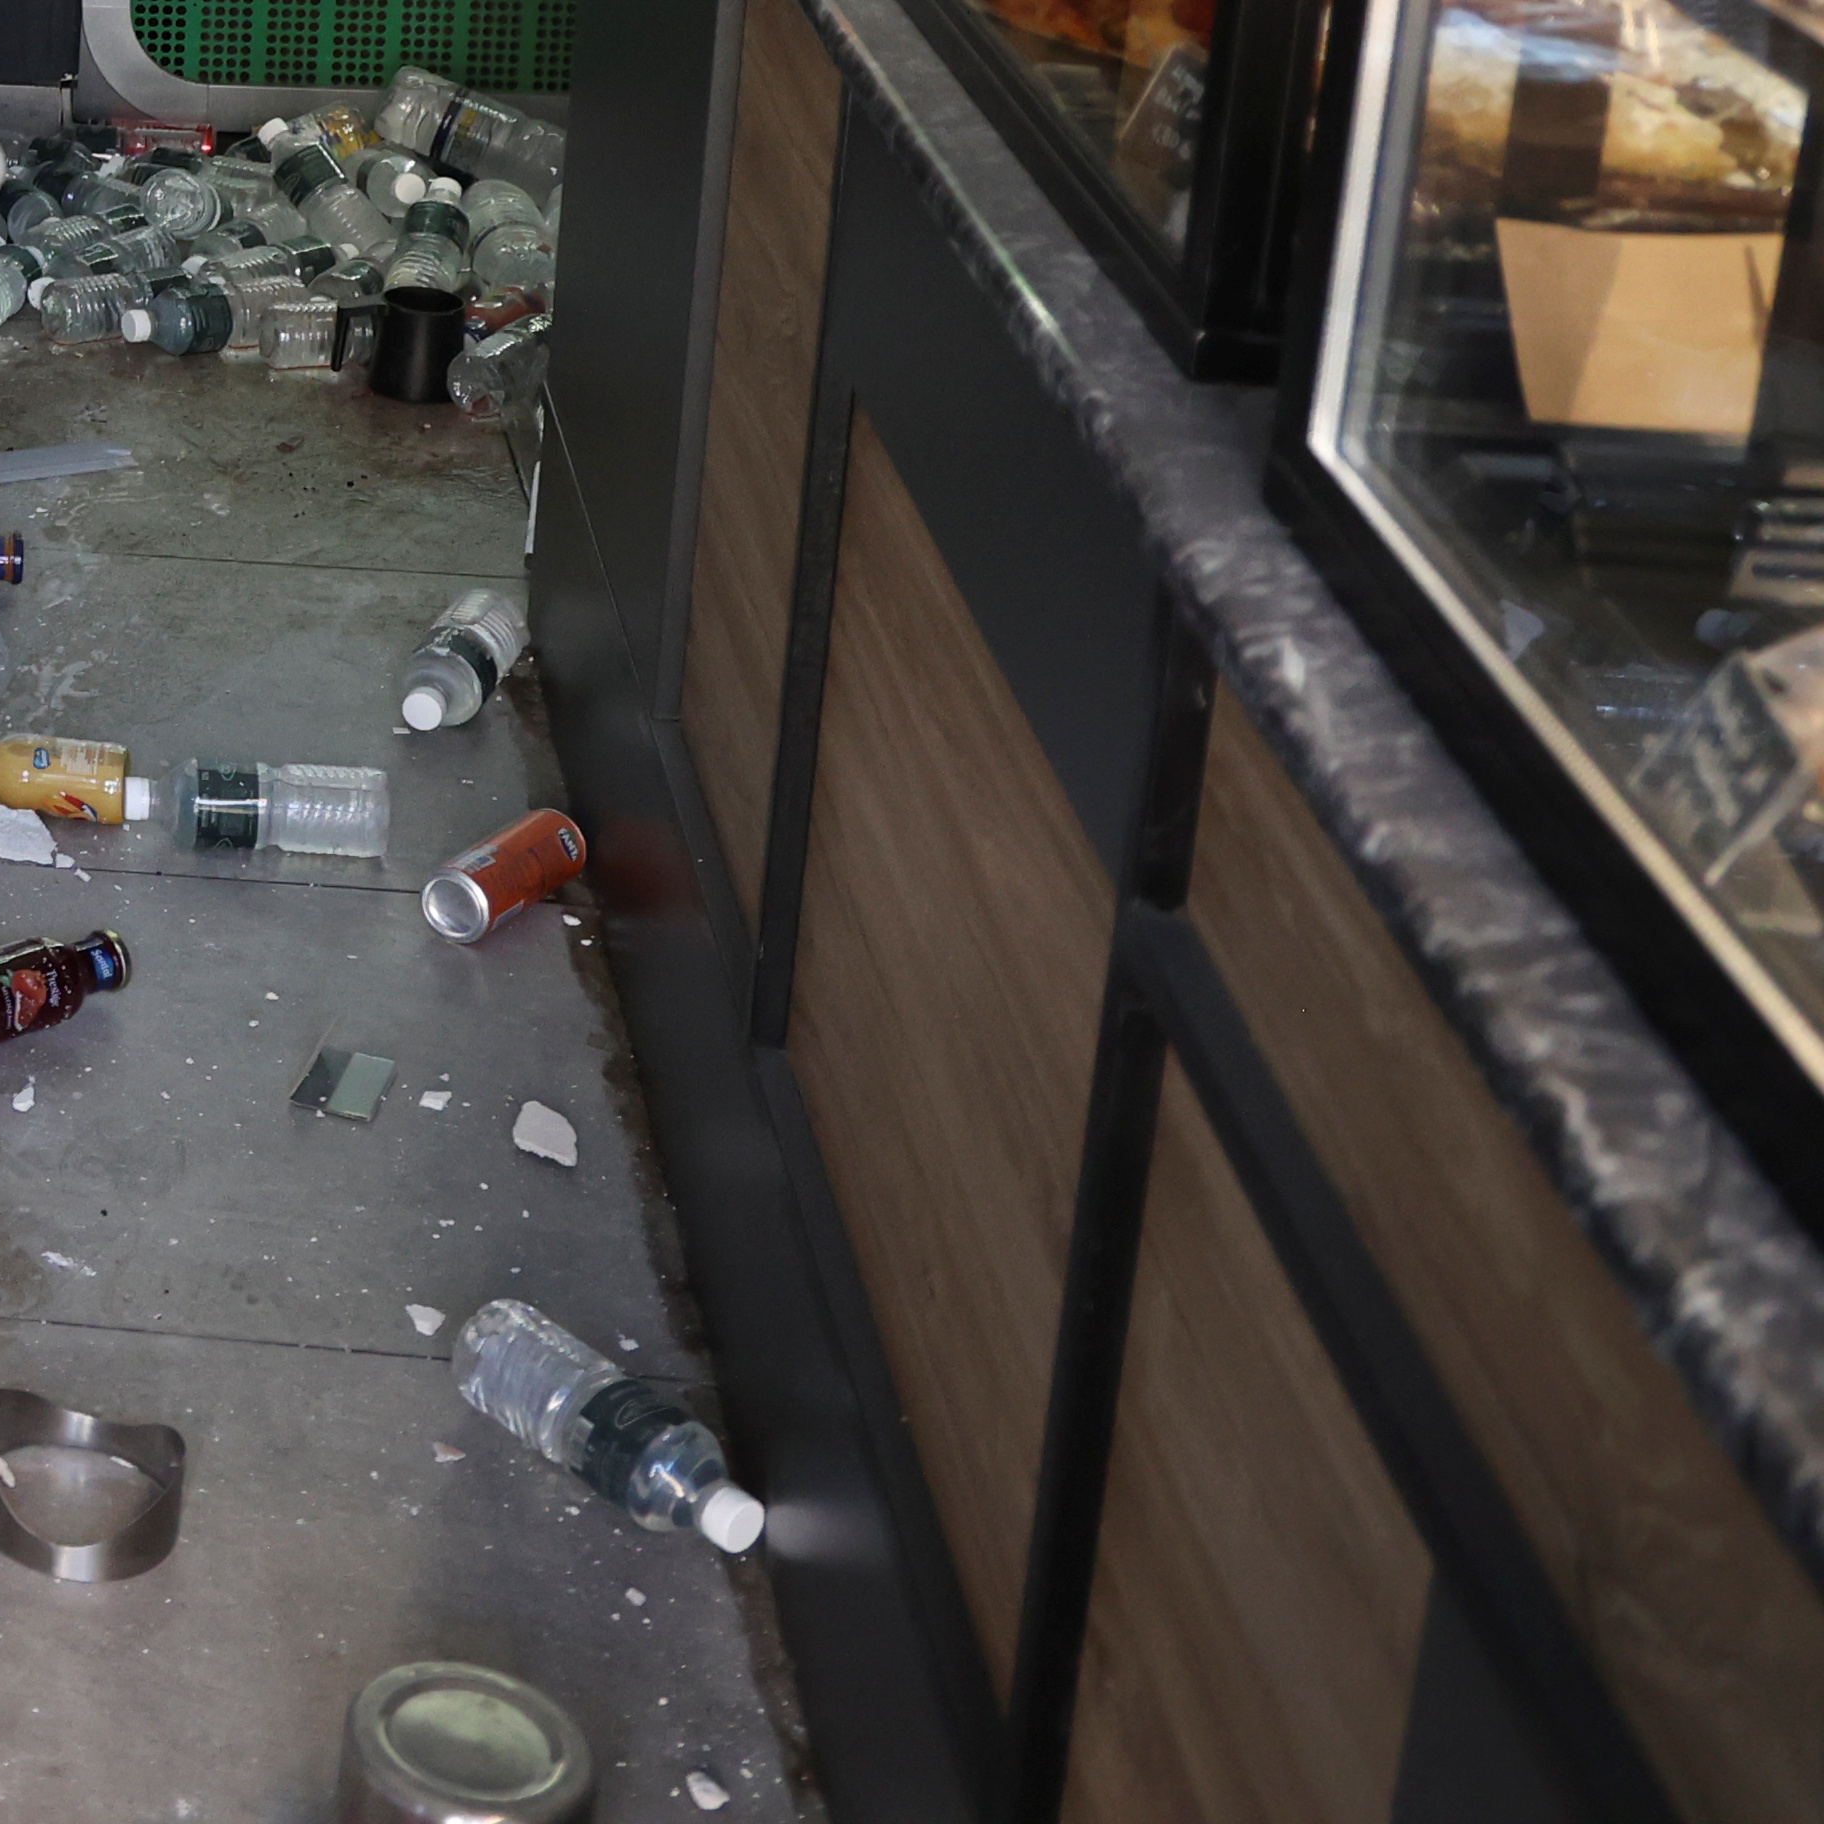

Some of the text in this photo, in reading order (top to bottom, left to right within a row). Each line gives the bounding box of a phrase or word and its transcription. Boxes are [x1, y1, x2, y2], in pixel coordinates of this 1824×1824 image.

[557, 827, 579, 862] FANTA
[90, 948, 113, 980] Santal
[46, 967, 62, 1009] Prestige
